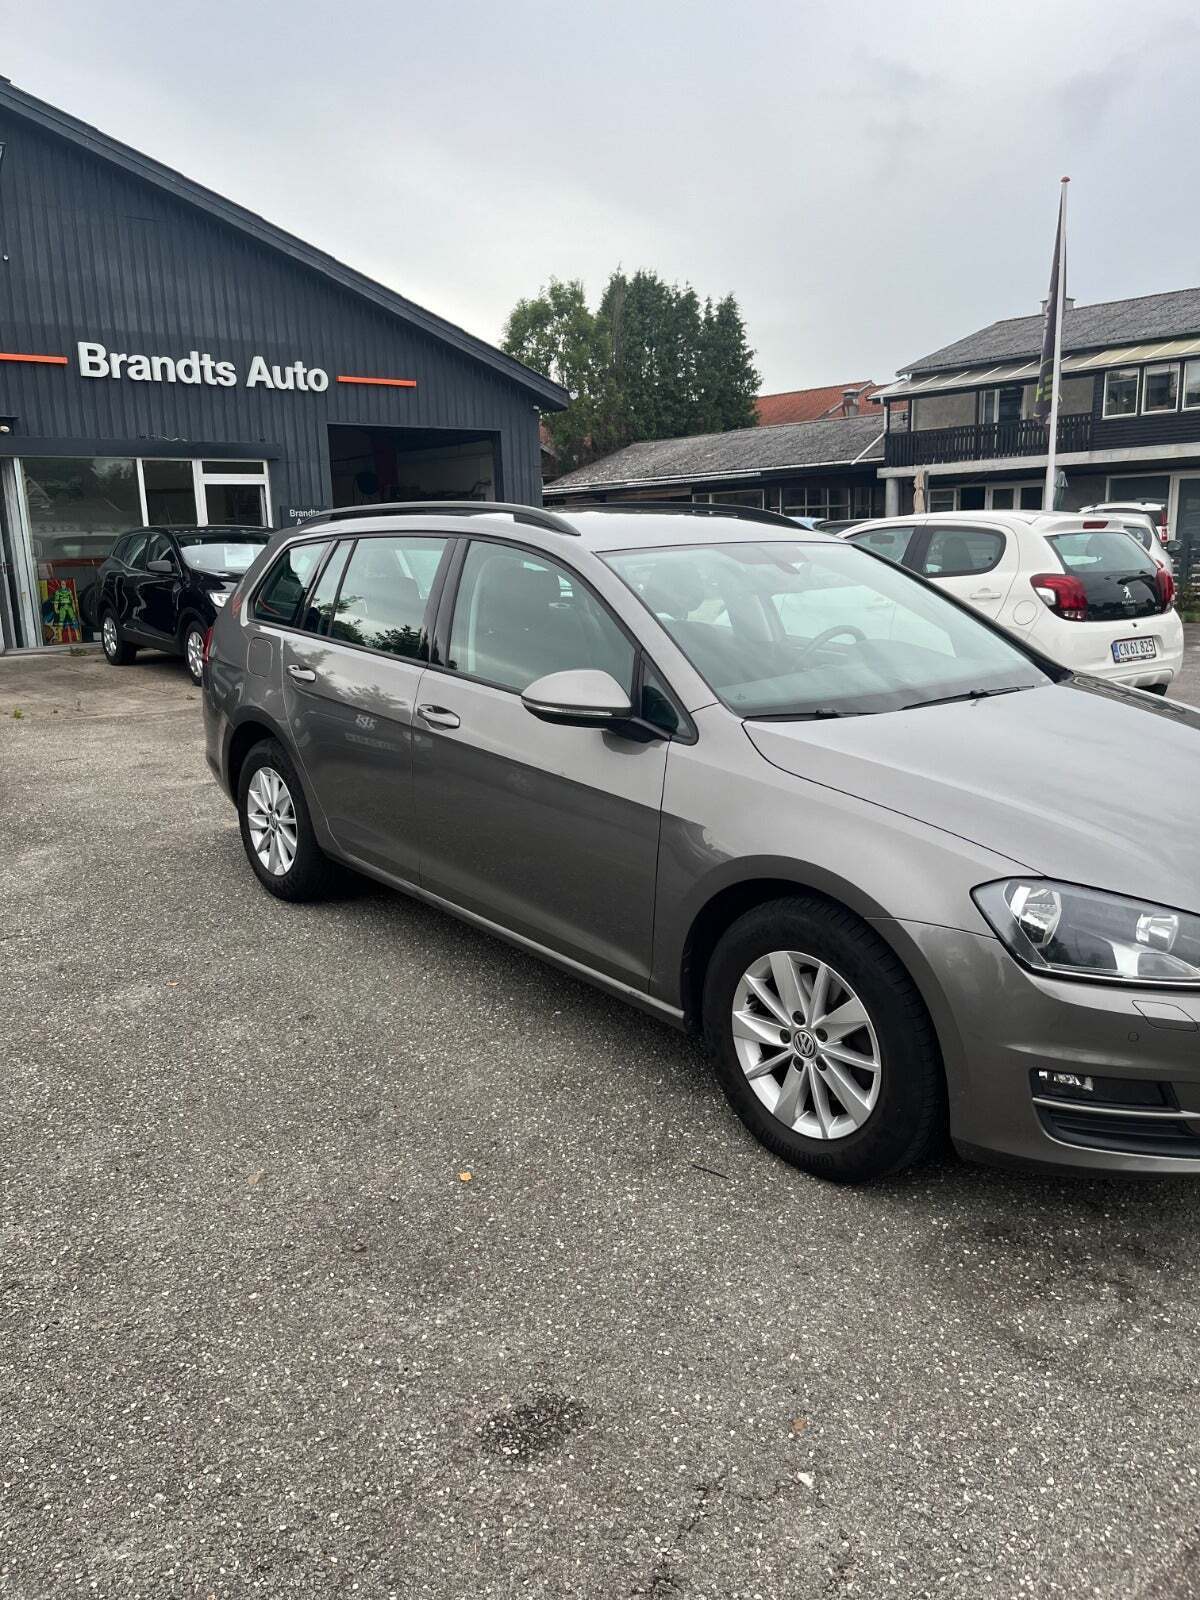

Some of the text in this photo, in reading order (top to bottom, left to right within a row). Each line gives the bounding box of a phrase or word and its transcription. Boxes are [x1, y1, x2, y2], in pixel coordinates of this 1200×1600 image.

[78, 341, 329, 392] Brandts Auto
[1119, 640, 1153, 656] CN 61 825
